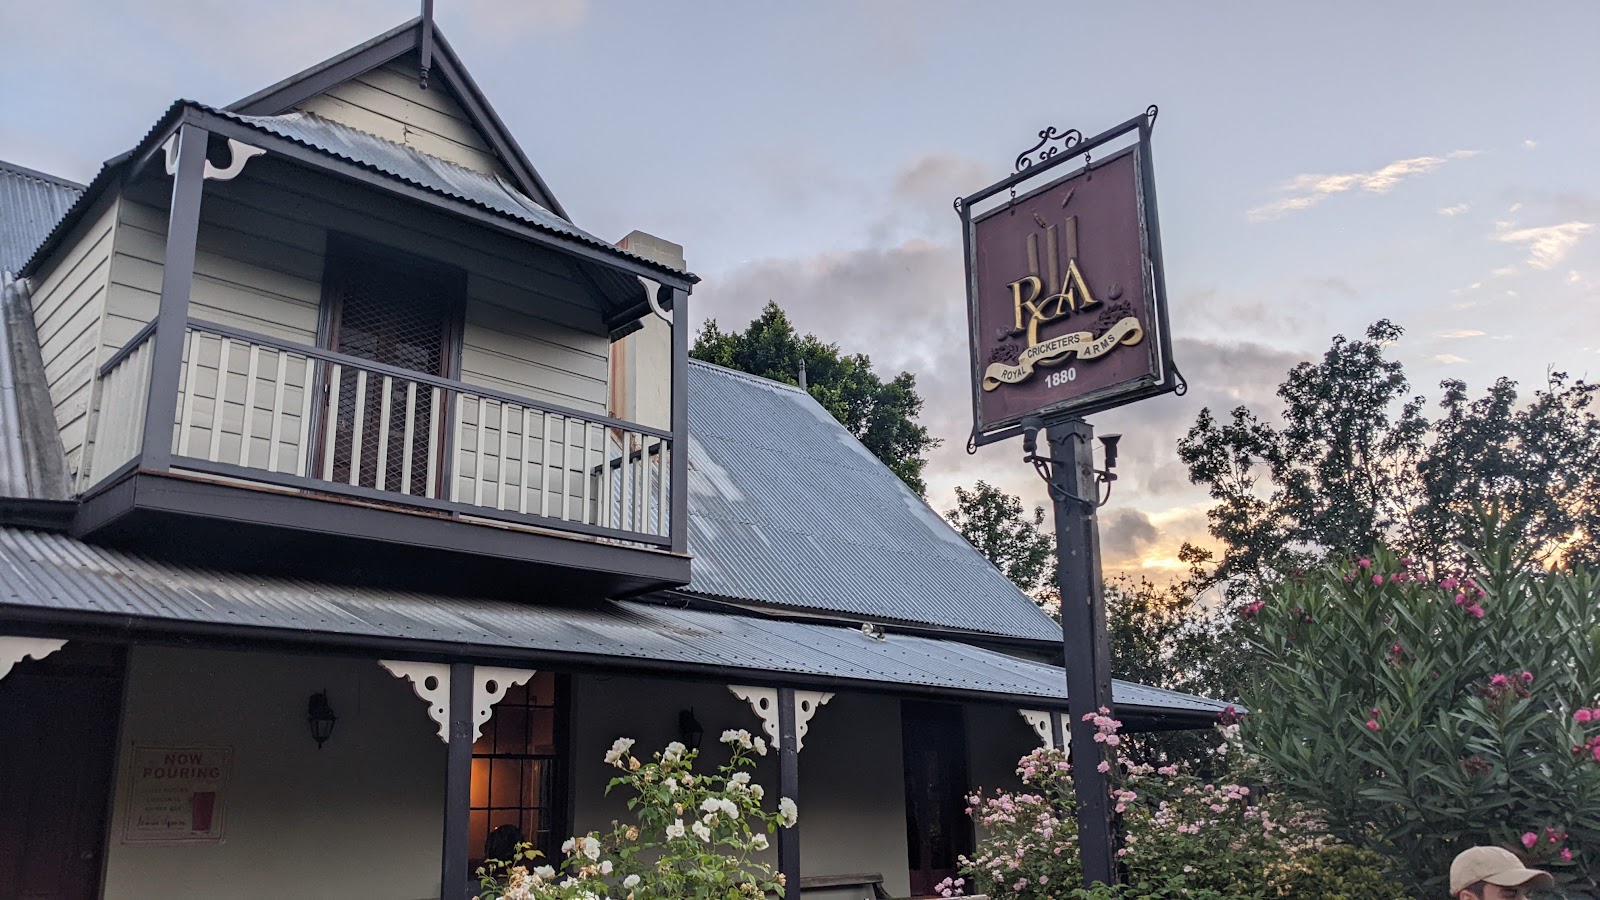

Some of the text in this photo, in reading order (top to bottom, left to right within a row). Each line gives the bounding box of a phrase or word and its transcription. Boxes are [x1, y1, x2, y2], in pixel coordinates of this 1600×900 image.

[1001, 334, 1115, 381] ROYAL CRICKETERS ARMS
[1044, 367, 1077, 389] 1880
[164, 753, 202, 765] NOW
[143, 767, 221, 779] POURING
